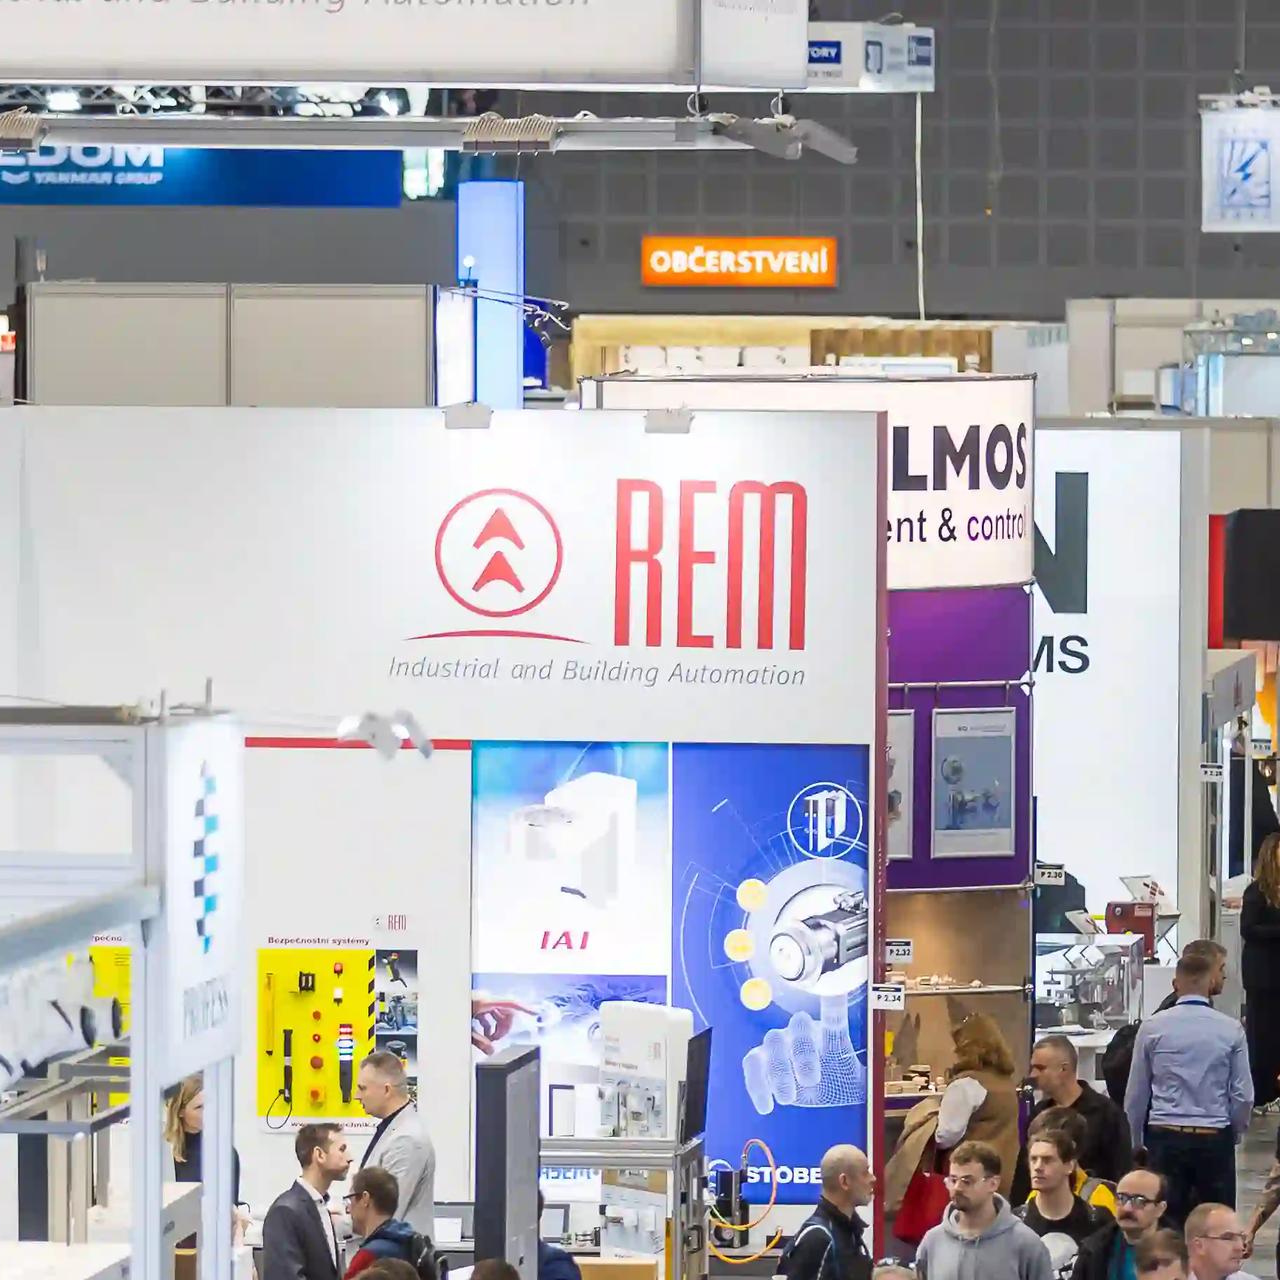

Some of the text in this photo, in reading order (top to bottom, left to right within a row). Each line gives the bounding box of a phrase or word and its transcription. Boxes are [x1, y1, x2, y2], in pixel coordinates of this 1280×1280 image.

[649, 244, 829, 274] OBČERSTVENÍ
[892, 422, 1027, 491] LMOS
[938, 507, 957, 542] &
[614, 477, 809, 651] REM
[388, 656, 806, 688] Industrial and Building Automation
[540, 930, 590, 950] IAI
[747, 1164, 823, 1185] STÖBE
